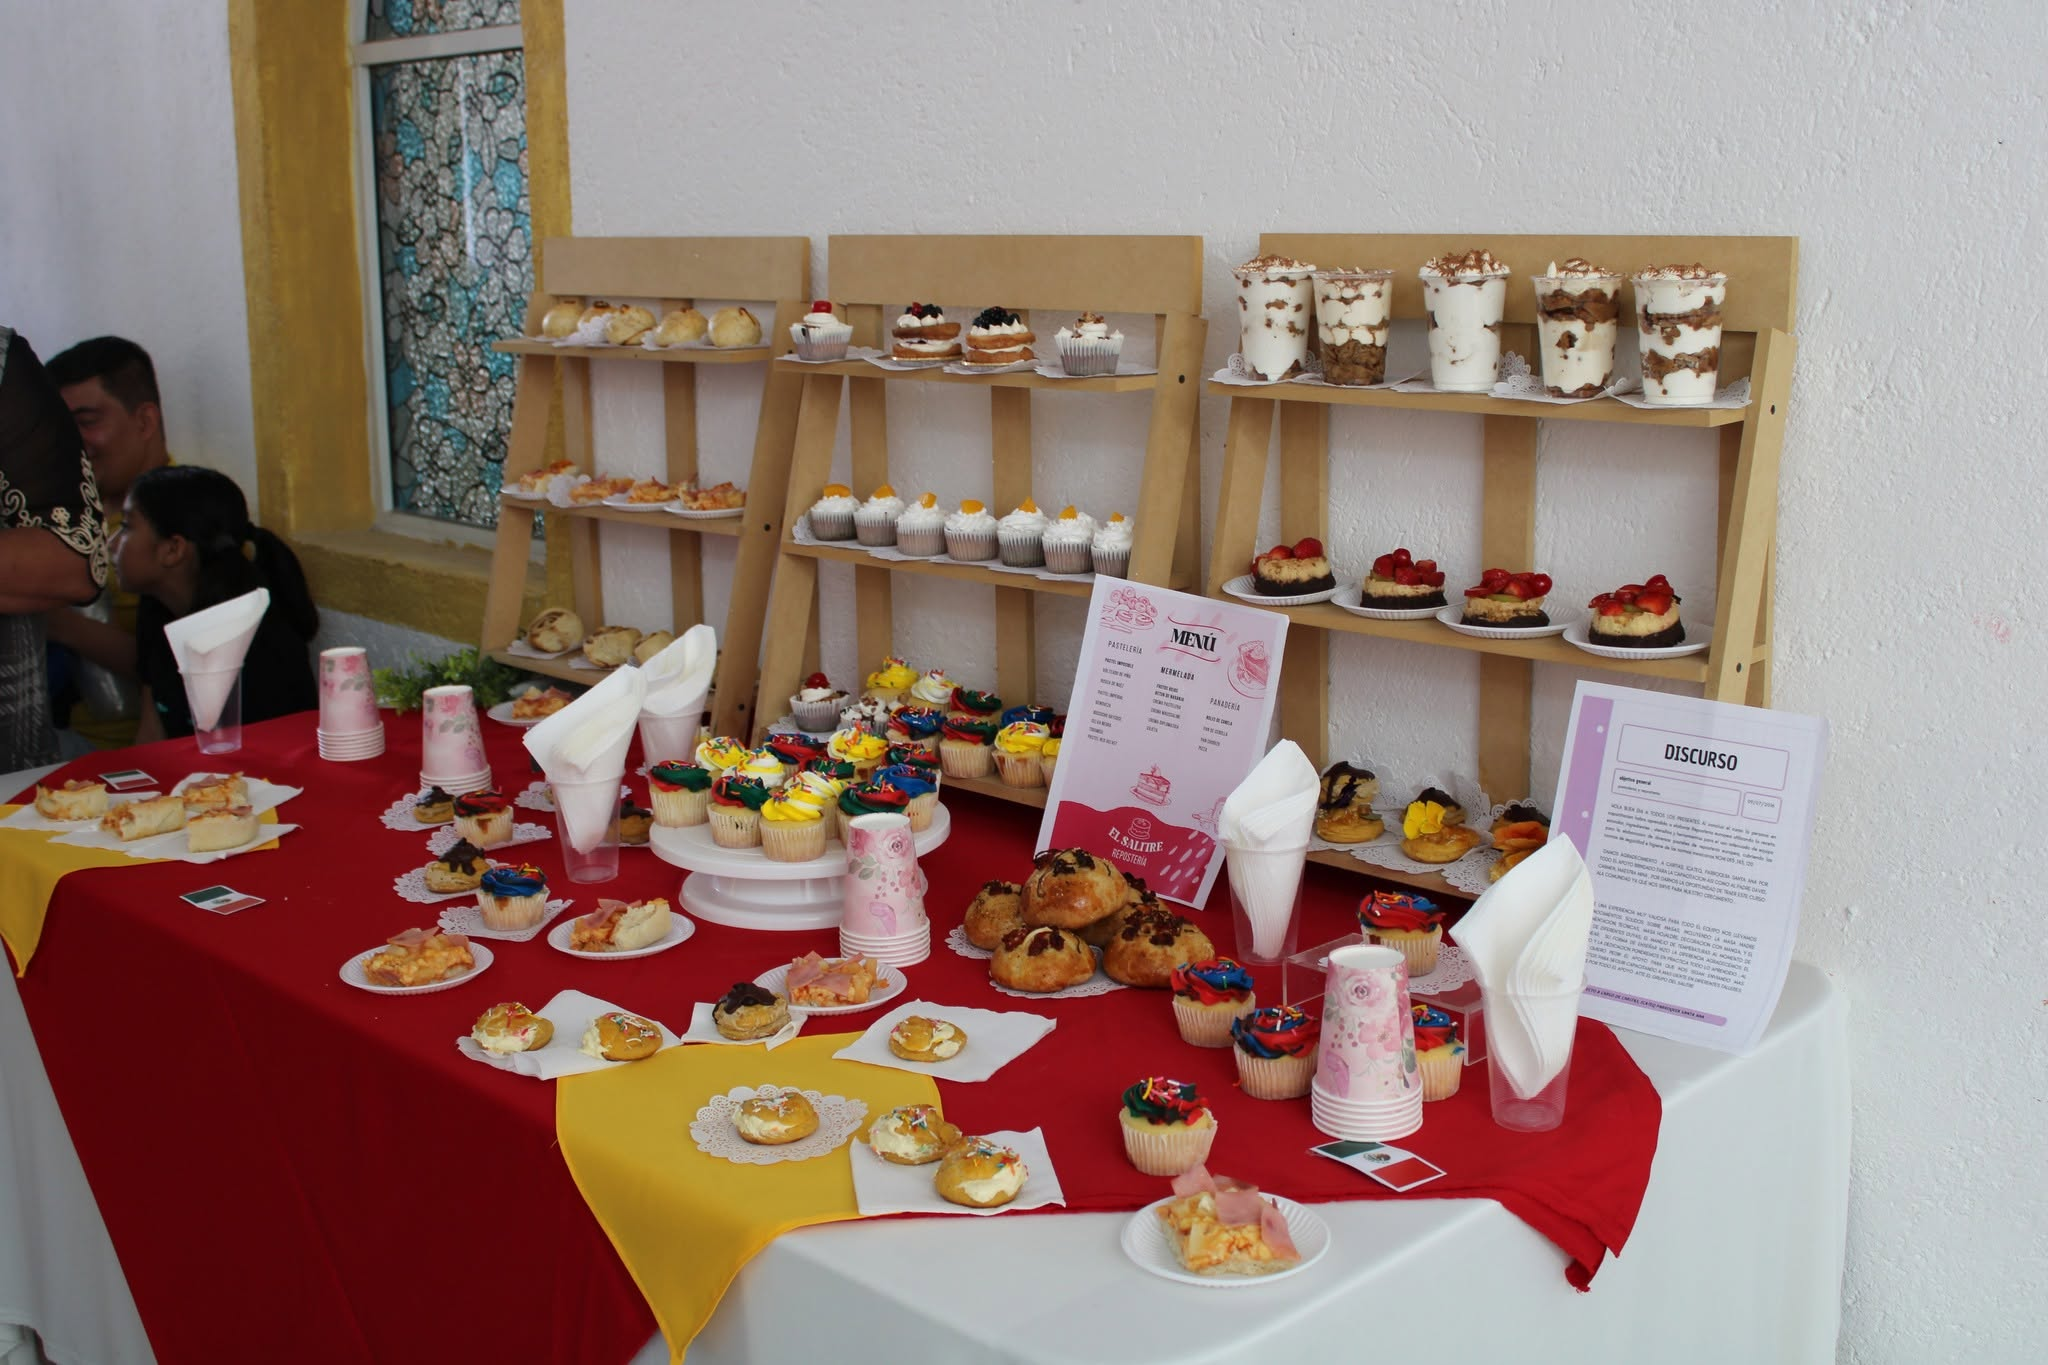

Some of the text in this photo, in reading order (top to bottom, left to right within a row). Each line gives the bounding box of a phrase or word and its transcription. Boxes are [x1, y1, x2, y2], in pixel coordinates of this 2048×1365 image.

[1108, 640, 1143, 655] PASTELERÍA
[1170, 628, 1217, 652] MENÚ
[1160, 667, 1195, 681] MERMELADA
[1209, 697, 1241, 712] PANADERÍA
[1664, 743, 1738, 771] DISCURSO
[1108, 827, 1164, 853] EL SALITRE
[1111, 848, 1148, 867] REPOSTERÍA
